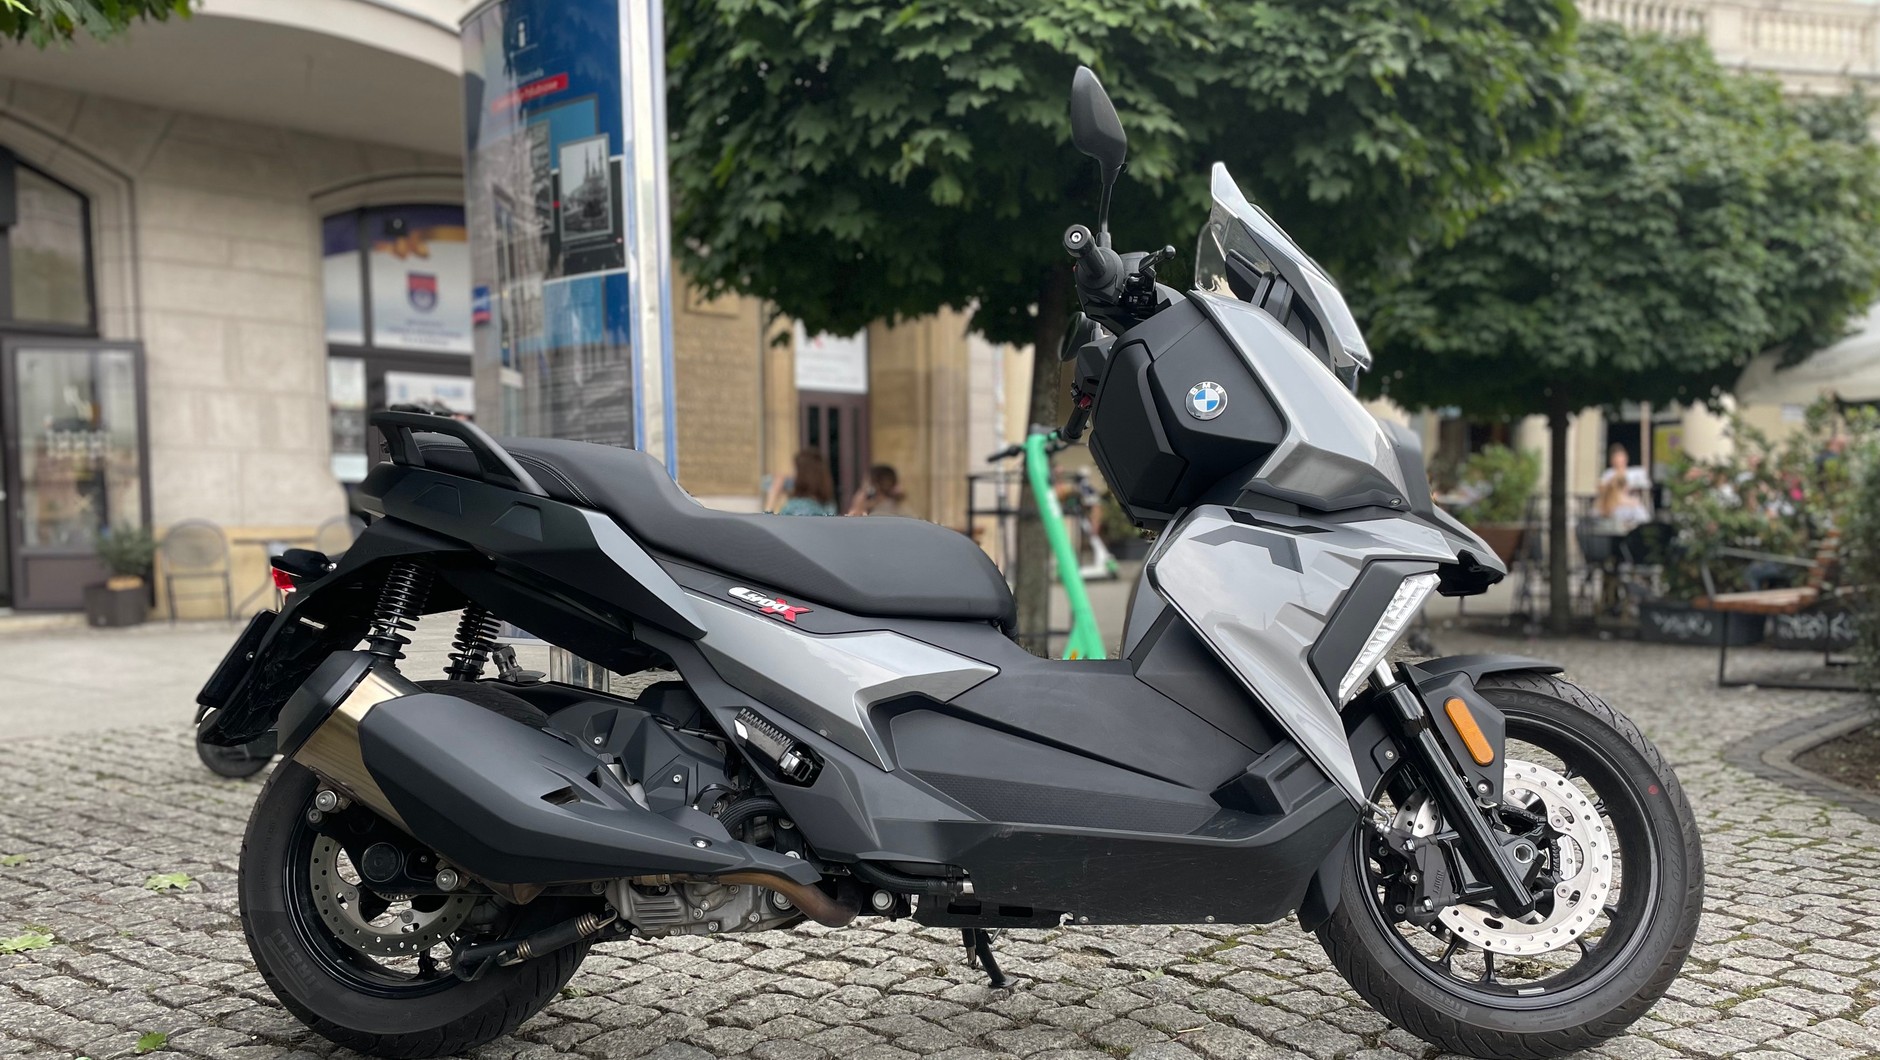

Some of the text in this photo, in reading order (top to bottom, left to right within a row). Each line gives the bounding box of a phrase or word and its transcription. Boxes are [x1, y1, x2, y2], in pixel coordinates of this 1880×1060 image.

[1190, 381, 1224, 396] BMW
[264, 928, 323, 998] PIRELLI
[1413, 981, 1468, 1019] PIRELLI
